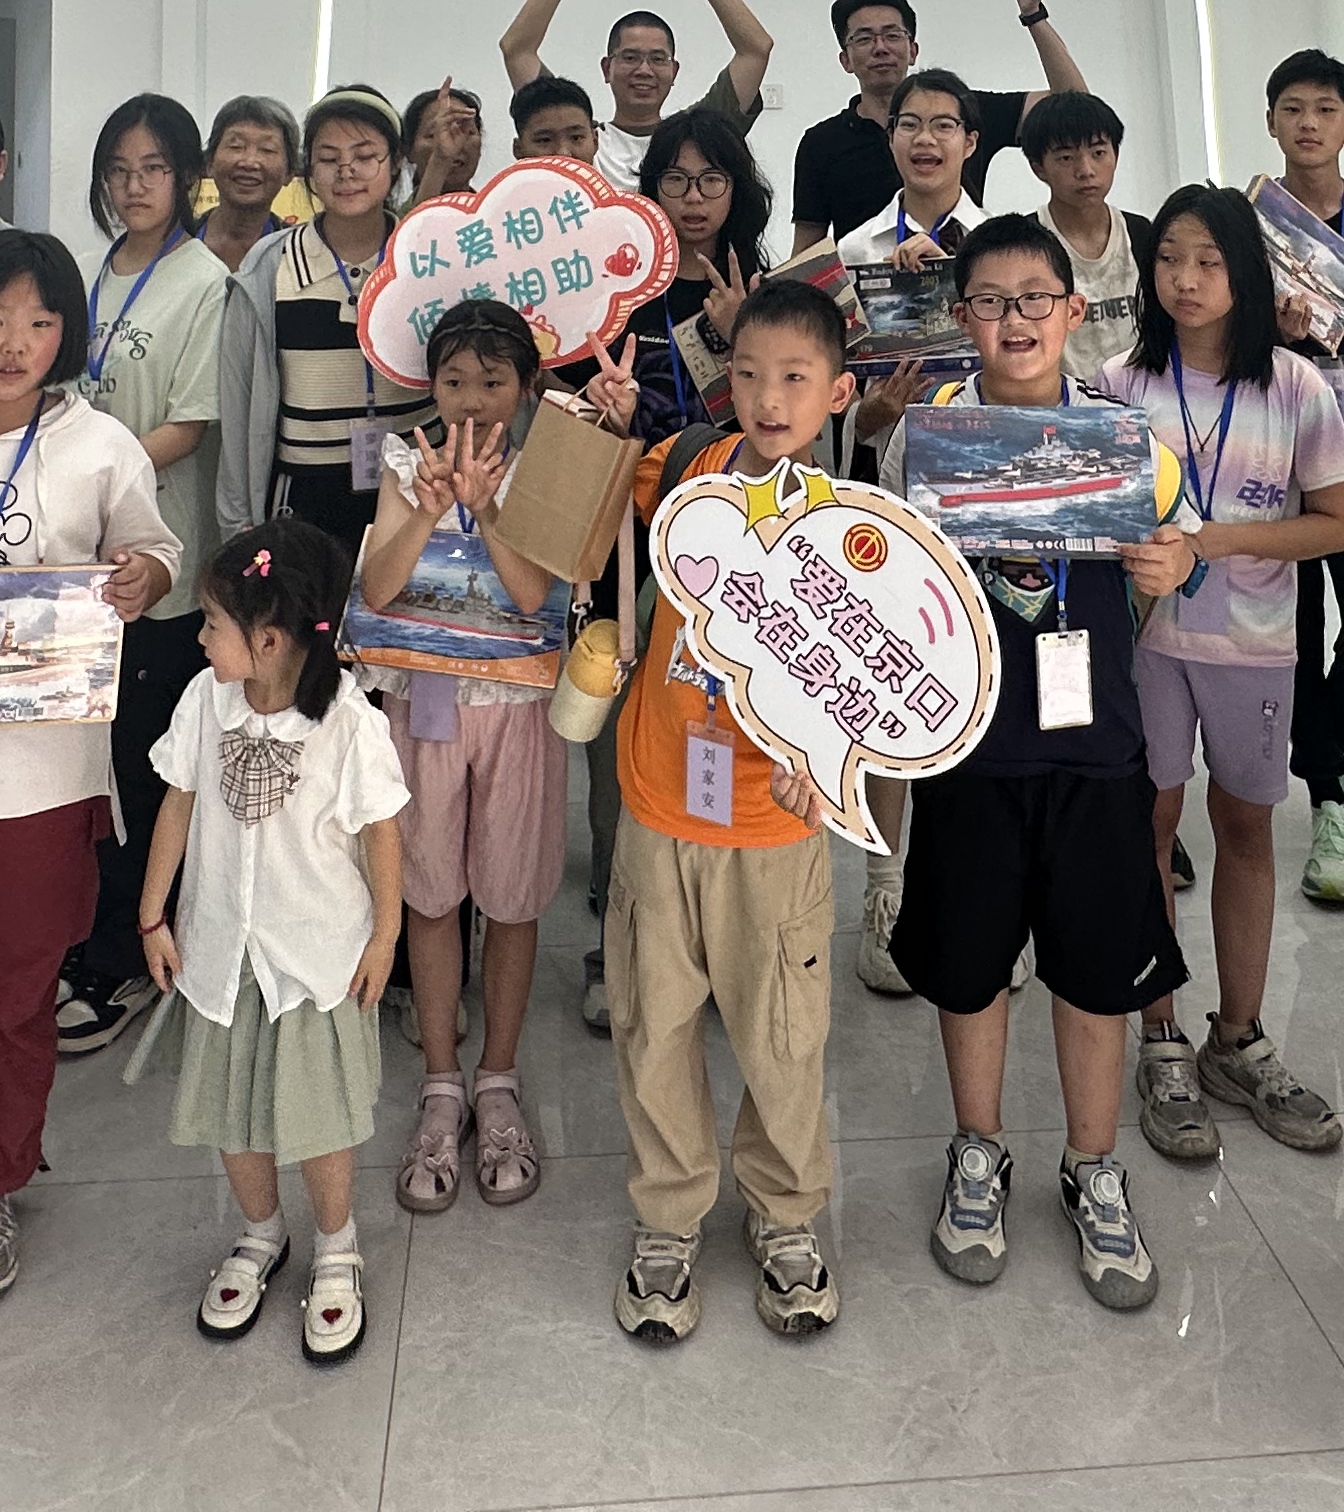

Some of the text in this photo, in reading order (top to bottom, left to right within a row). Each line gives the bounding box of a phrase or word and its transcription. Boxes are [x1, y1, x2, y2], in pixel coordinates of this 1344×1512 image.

[409, 189, 591, 280] 以爱相伴
[720, 570, 907, 743] 会在身边”
[787, 535, 959, 732] “爱在京口
